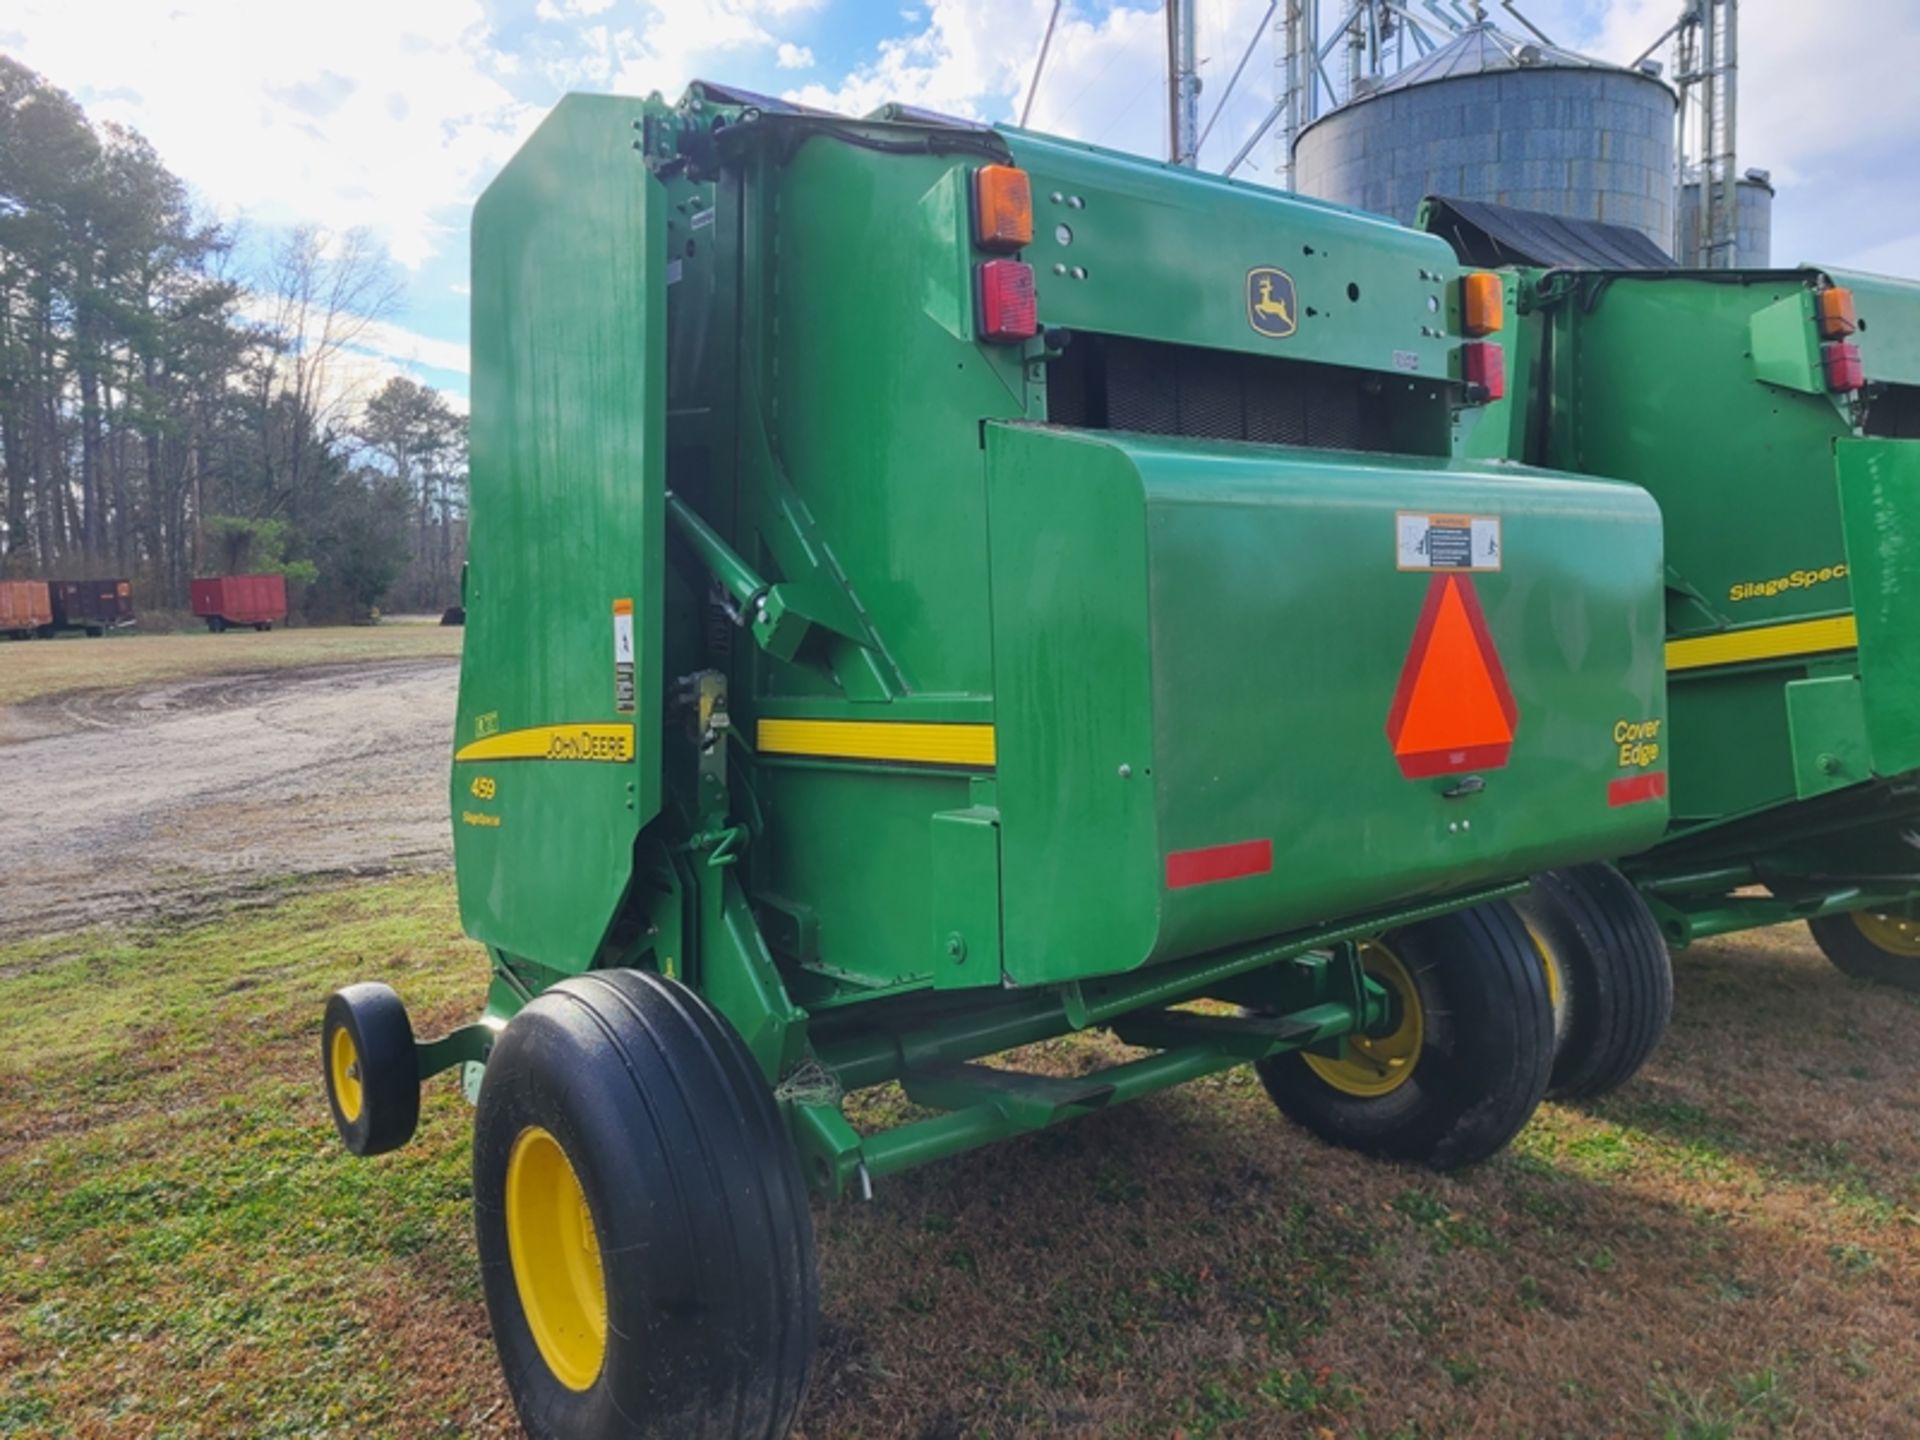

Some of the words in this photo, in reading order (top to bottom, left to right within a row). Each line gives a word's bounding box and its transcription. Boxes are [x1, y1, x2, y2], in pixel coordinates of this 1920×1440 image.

[1614, 720, 1661, 742] Cover
[546, 732, 580, 757] JOHN
[581, 731, 627, 758] DEERE
[1618, 742, 1659, 767] Edge
[470, 776, 497, 800] 459
